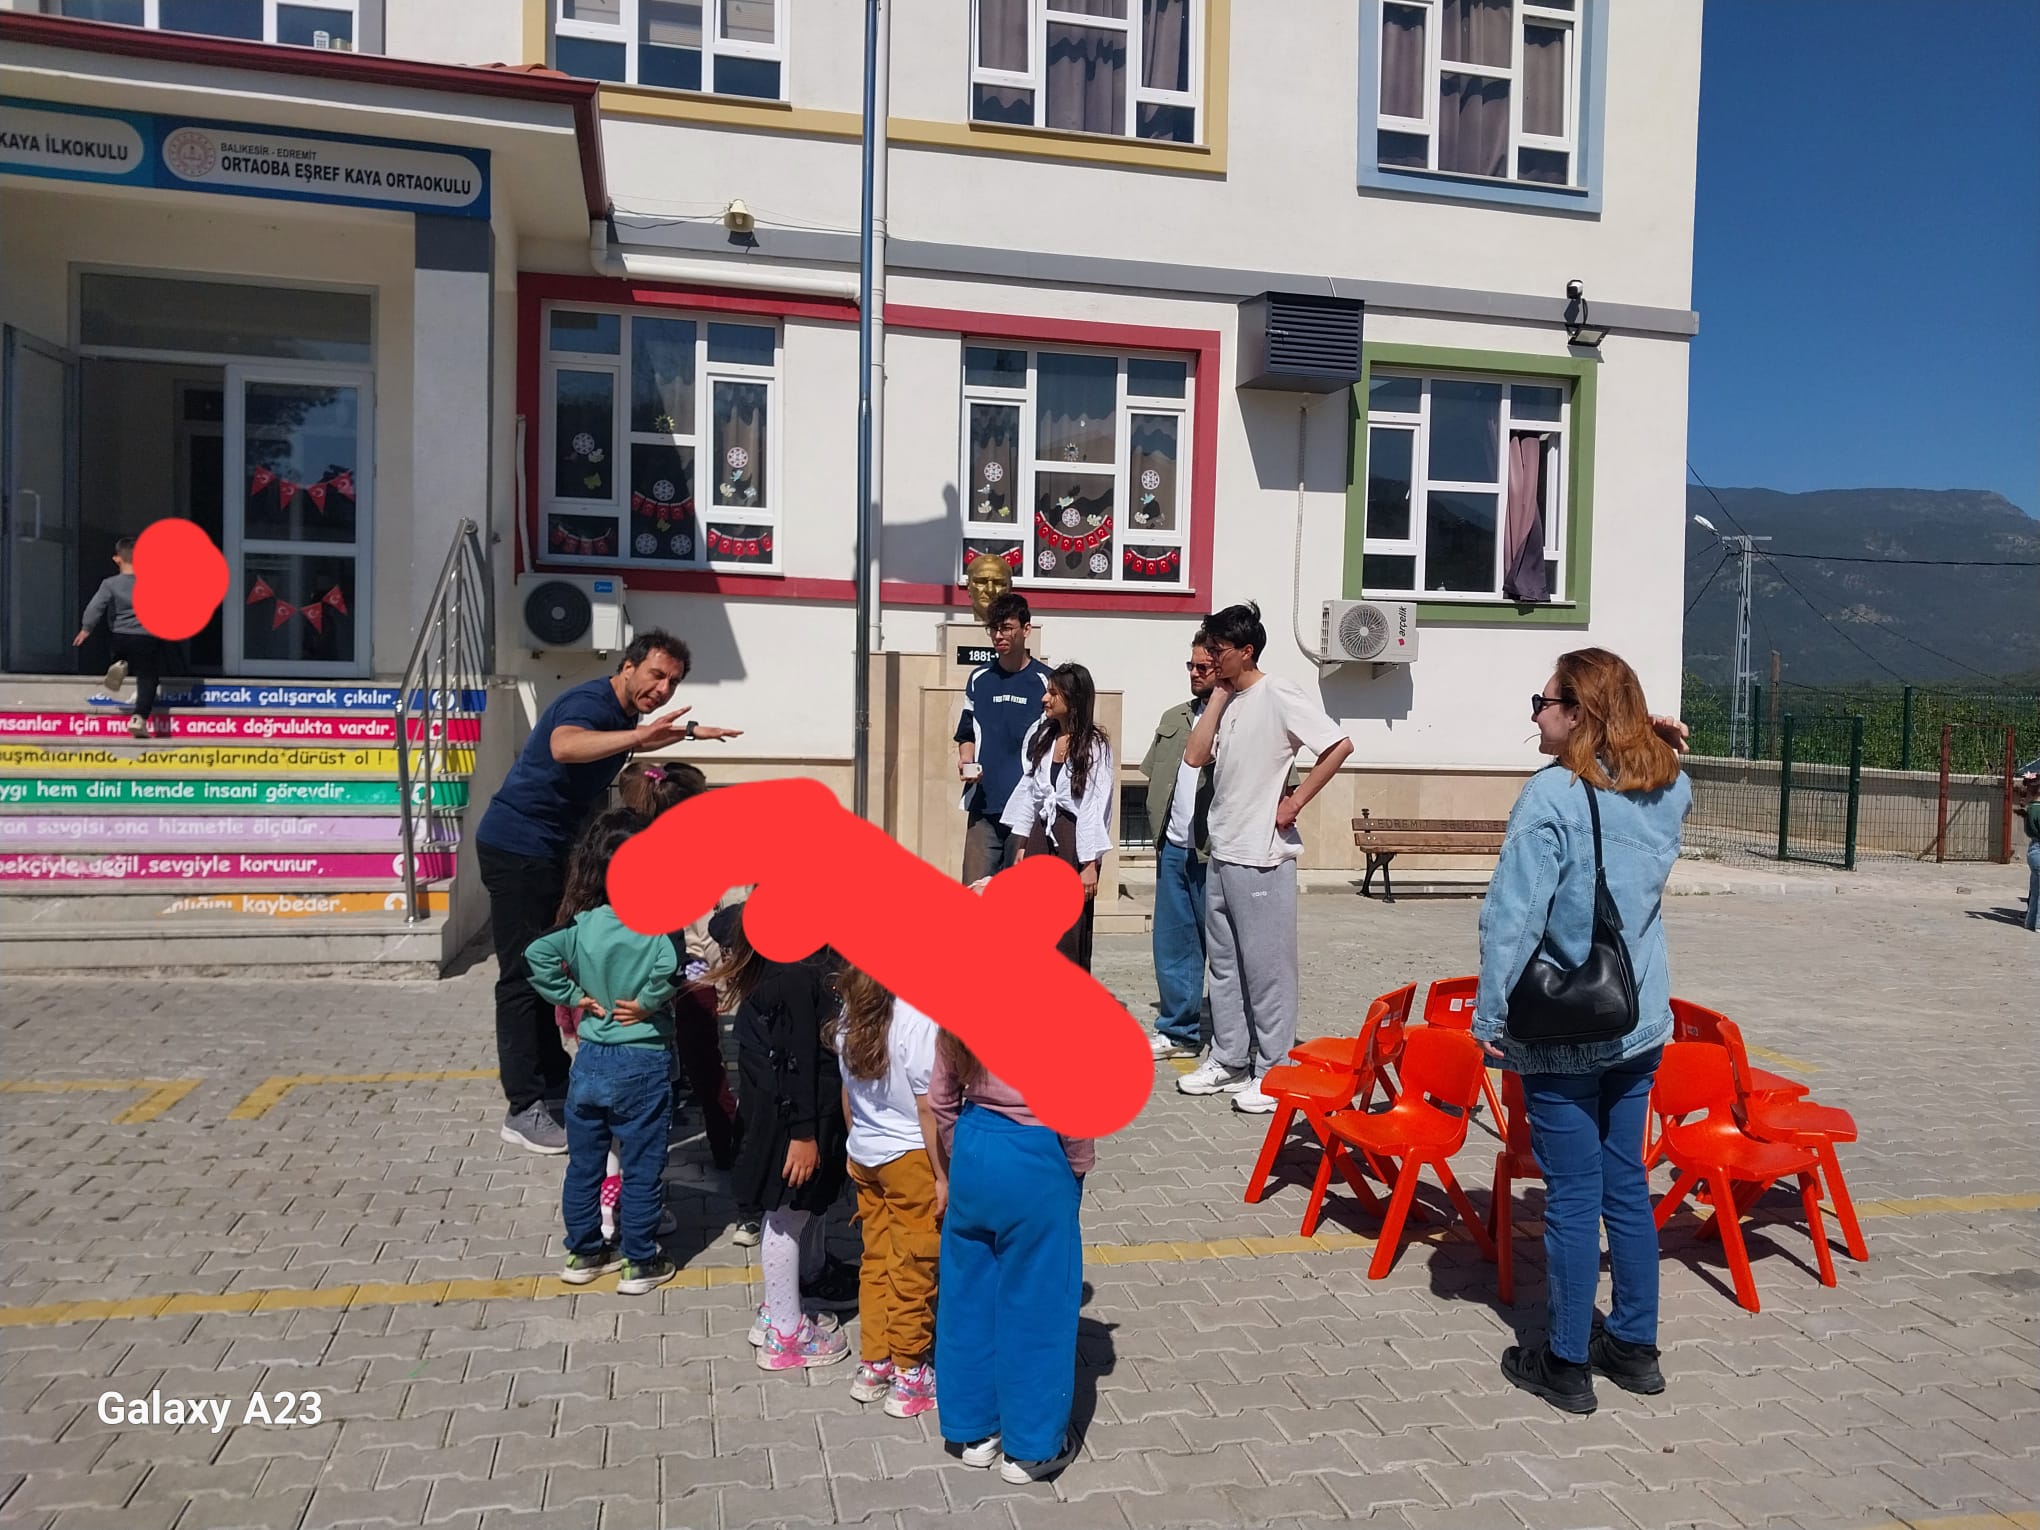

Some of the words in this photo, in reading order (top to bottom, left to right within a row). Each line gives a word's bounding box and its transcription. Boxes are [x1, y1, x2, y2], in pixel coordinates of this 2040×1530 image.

[0, 131, 40, 152] KAYA
[45, 133, 128, 160] İLKOKULU
[220, 142, 270, 155] BALIKESİR
[276, 148, 317, 160] EDREMİT
[221, 156, 290, 177] ORTAOBA
[295, 163, 340, 183] EŞREF
[344, 168, 382, 186] KAYA
[386, 172, 471, 195] ORTAOKULU
[258, 687, 337, 706] çalışarak
[69, 717, 100, 735] için
[106, 716, 180, 733] muuluk
[186, 719, 237, 734] ancak
[243, 718, 333, 738] doğrulukta
[338, 720, 396, 736] vardır.
[288, 752, 346, 765] dürüst
[354, 752, 370, 765] ol
[37, 780, 77, 797] hem
[86, 781, 121, 798] dini
[131, 781, 195, 798] hemde
[204, 783, 257, 798] insani
[265, 782, 351, 802] görevdir.
[158, 818, 244, 834] hizmetle
[239, 855, 325, 874] korunur,
[242, 895, 347, 915] kaybeder.
